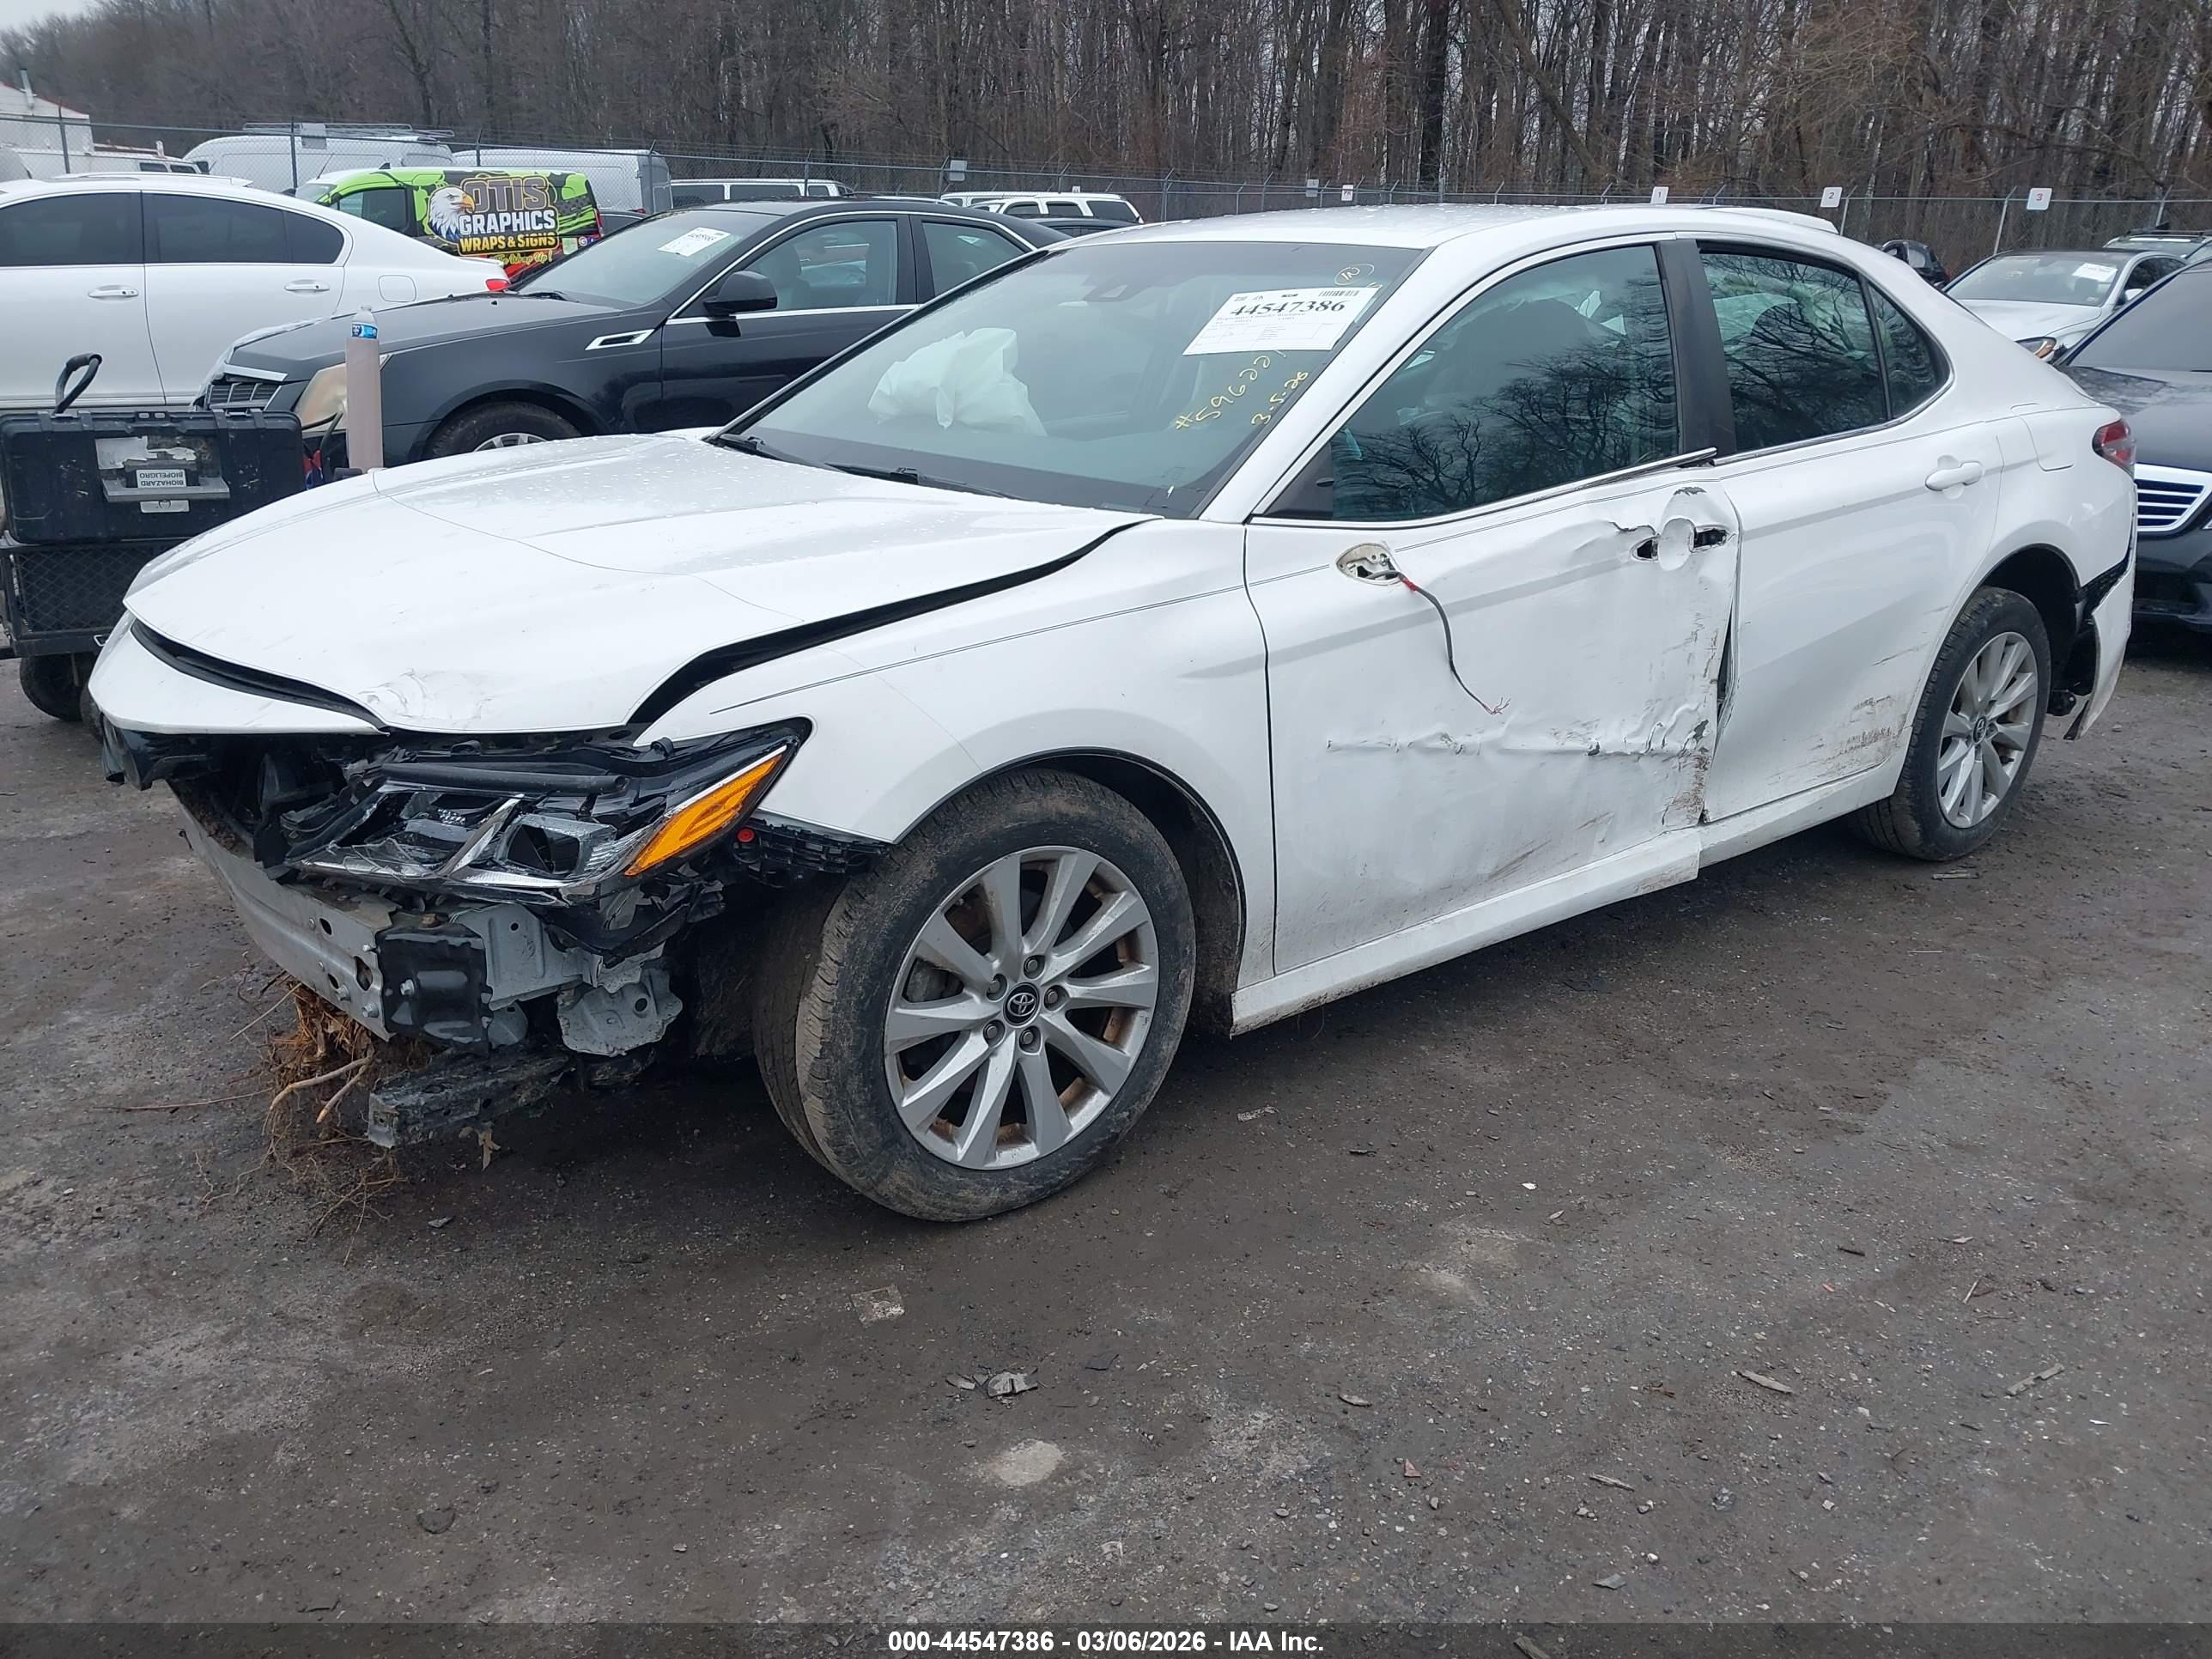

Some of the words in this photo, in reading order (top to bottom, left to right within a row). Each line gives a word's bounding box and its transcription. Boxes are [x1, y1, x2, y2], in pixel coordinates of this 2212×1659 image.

[465, 177, 548, 211] OTIS
[2036, 192, 2044, 201] 3
[459, 210, 556, 235] GRAPHICS
[460, 235, 507, 252] WRAPS
[507, 235, 516, 248] &
[1231, 300, 1350, 316] 44547386
